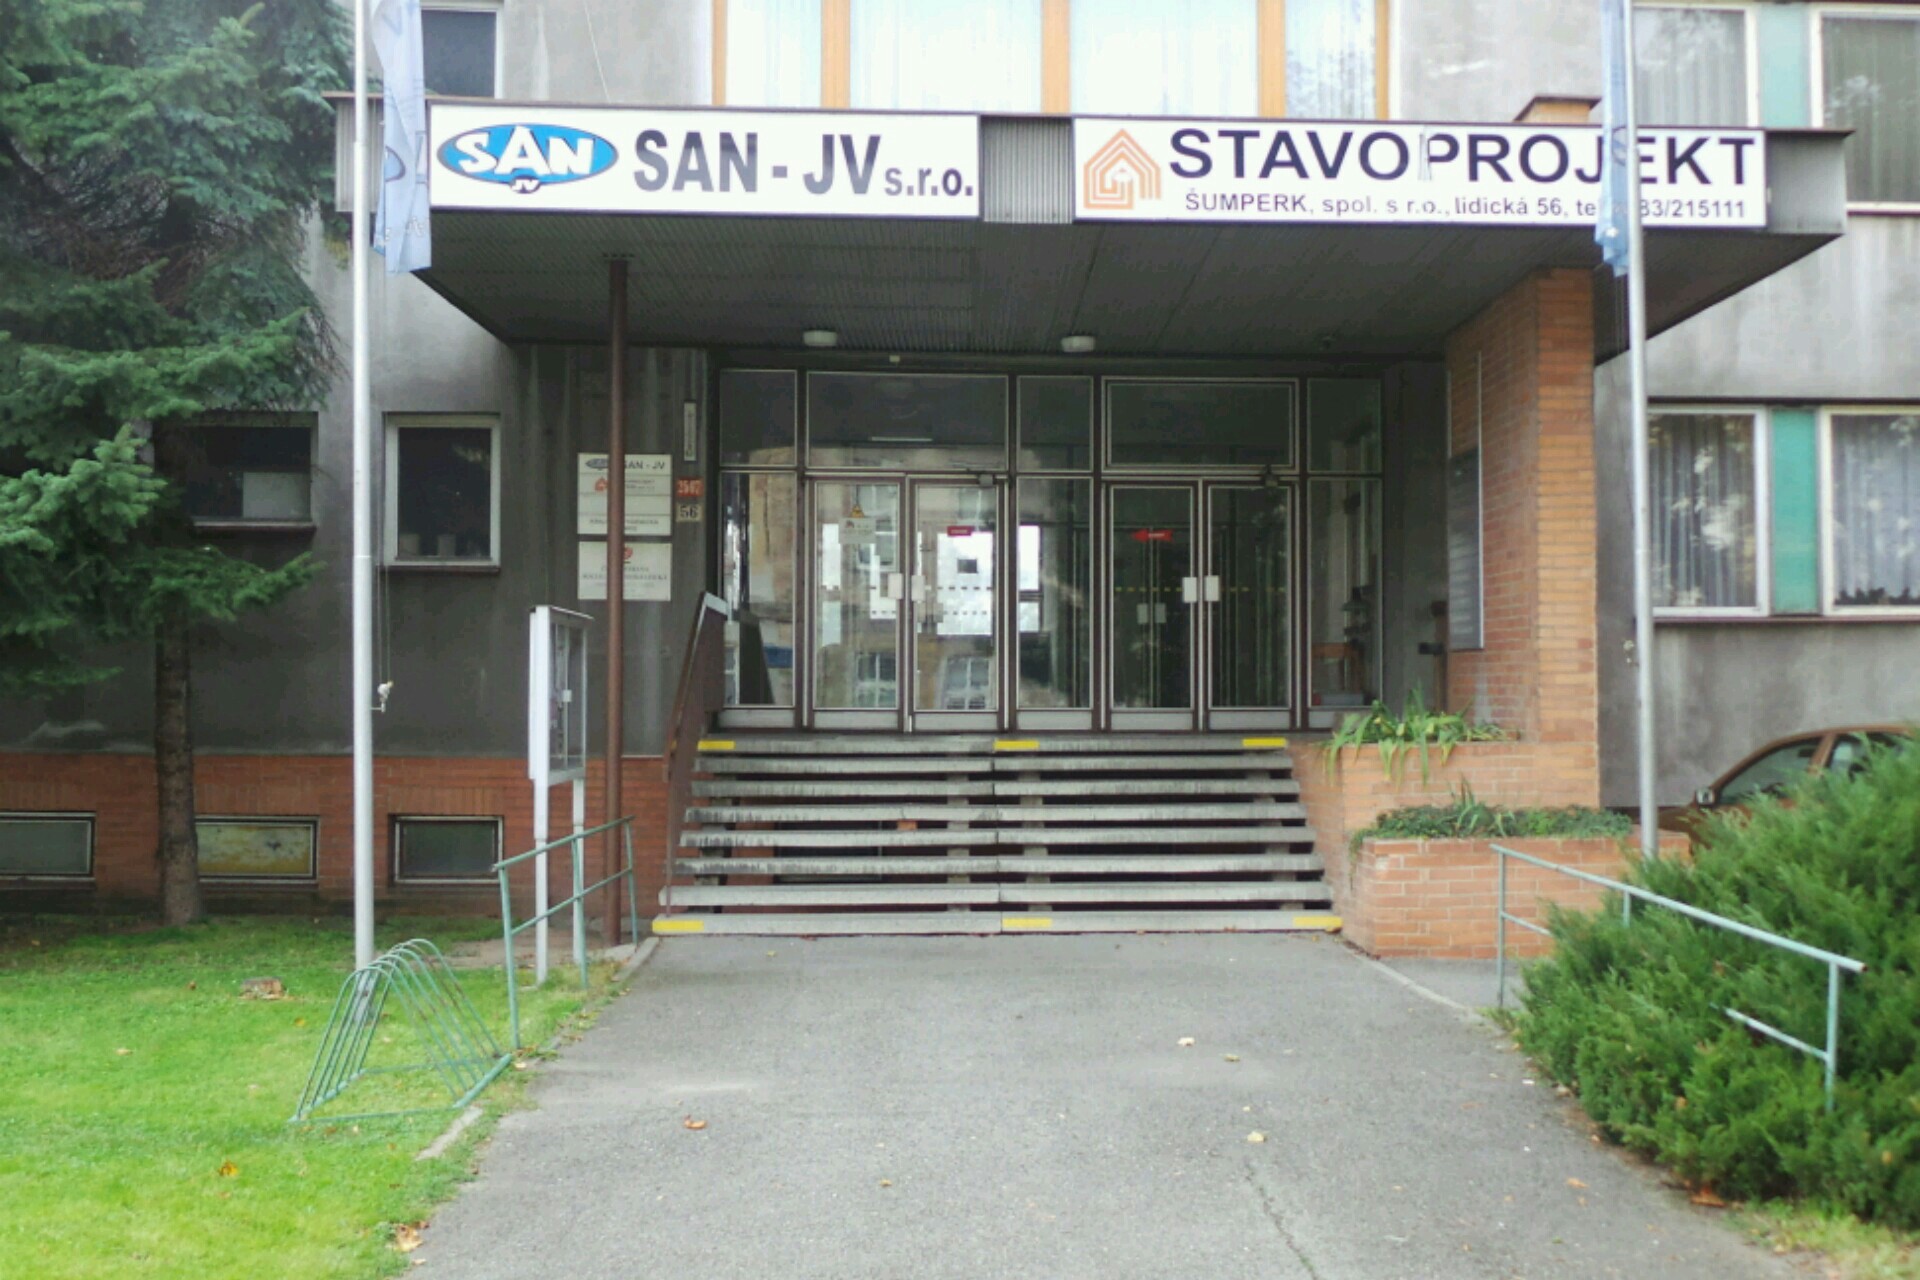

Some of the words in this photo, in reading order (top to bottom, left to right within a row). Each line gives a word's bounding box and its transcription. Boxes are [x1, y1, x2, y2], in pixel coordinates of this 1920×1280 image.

[455, 125, 595, 176] SAN
[633, 129, 758, 192] SAN
[803, 133, 882, 195] JV
[884, 167, 974, 197] s.r.o.
[1322, 196, 1377, 217] spol.
[679, 504, 698, 518] 56
